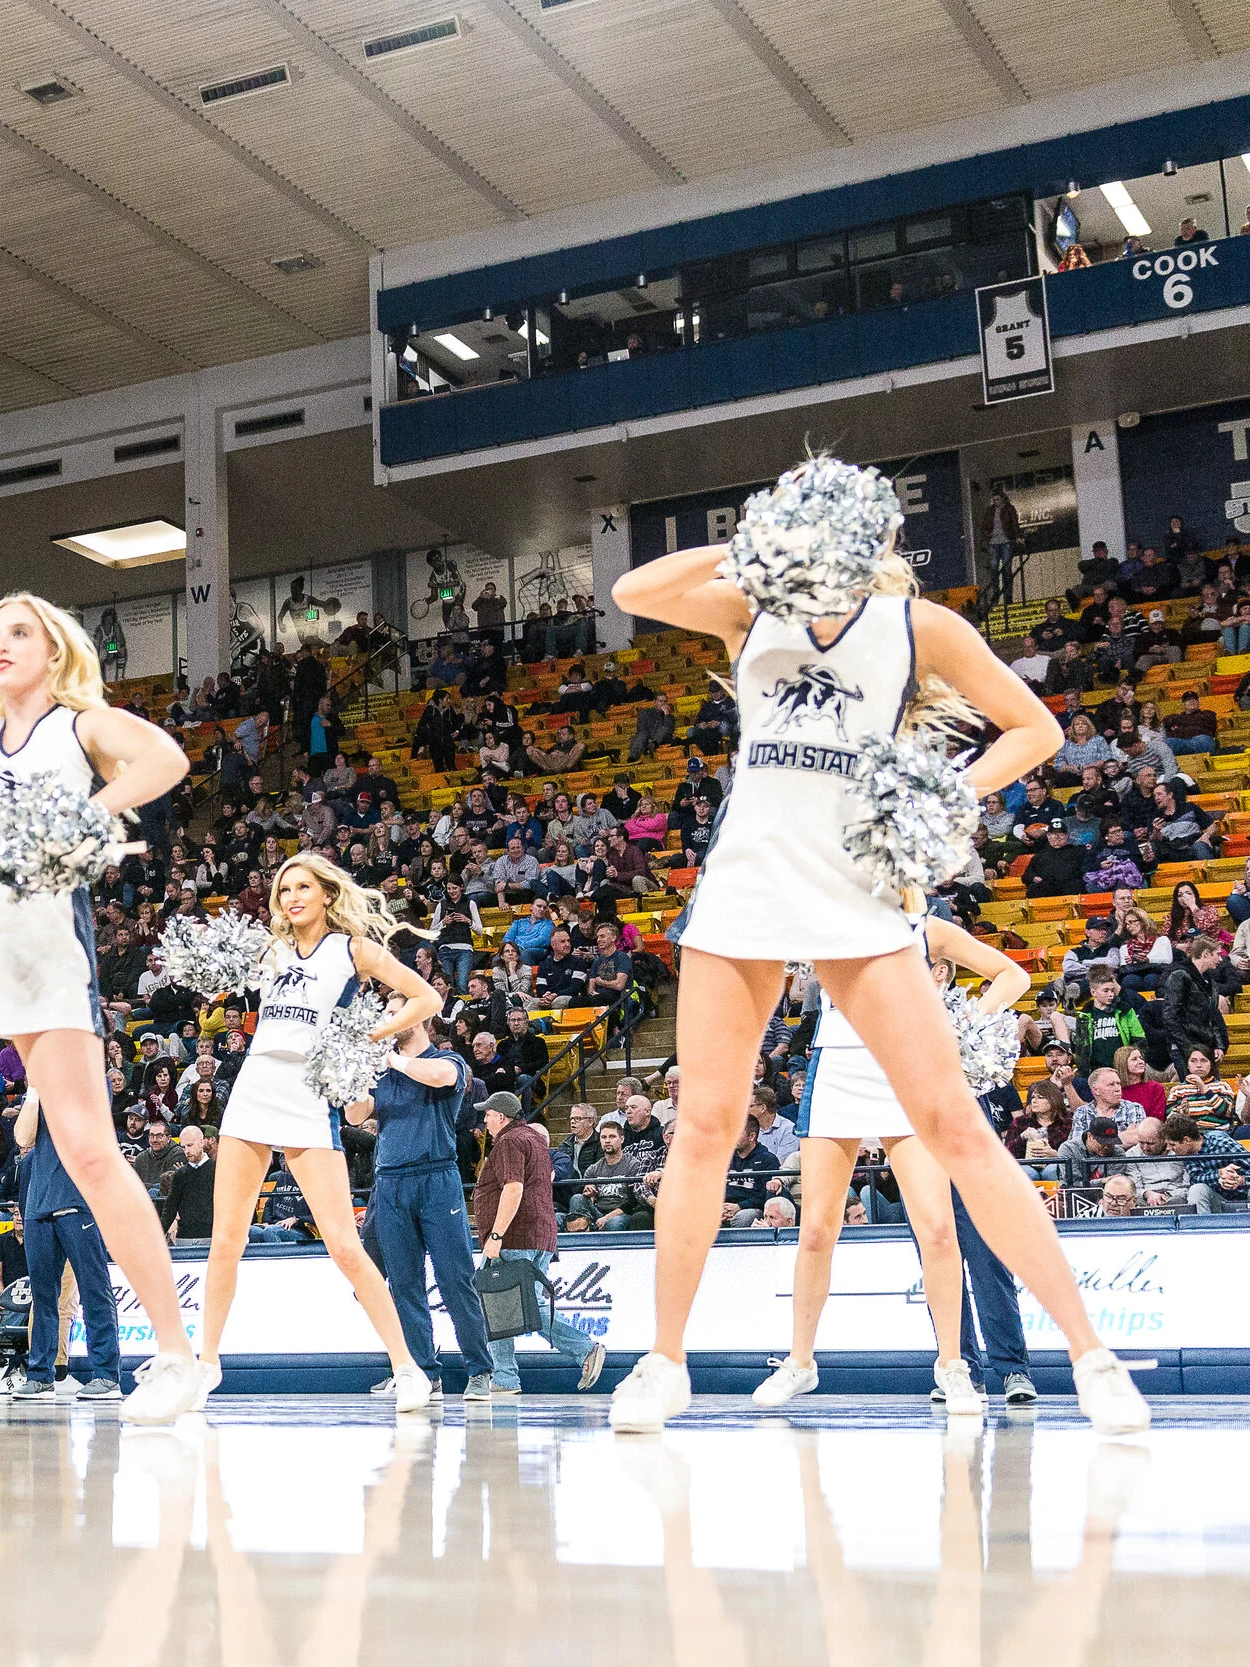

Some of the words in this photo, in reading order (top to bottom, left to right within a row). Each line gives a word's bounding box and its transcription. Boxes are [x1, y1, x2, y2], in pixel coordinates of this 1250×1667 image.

[1133, 245, 1219, 280] COOK
[1163, 273, 1193, 308] 6
[995, 319, 1030, 333] GRANT
[1006, 335, 1025, 360] 5
[1084, 430, 1104, 453] A
[600, 514, 617, 533] X
[191, 584, 210, 604] W
[800, 743, 858, 778] STAT
[284, 1005, 318, 1025] STATE
